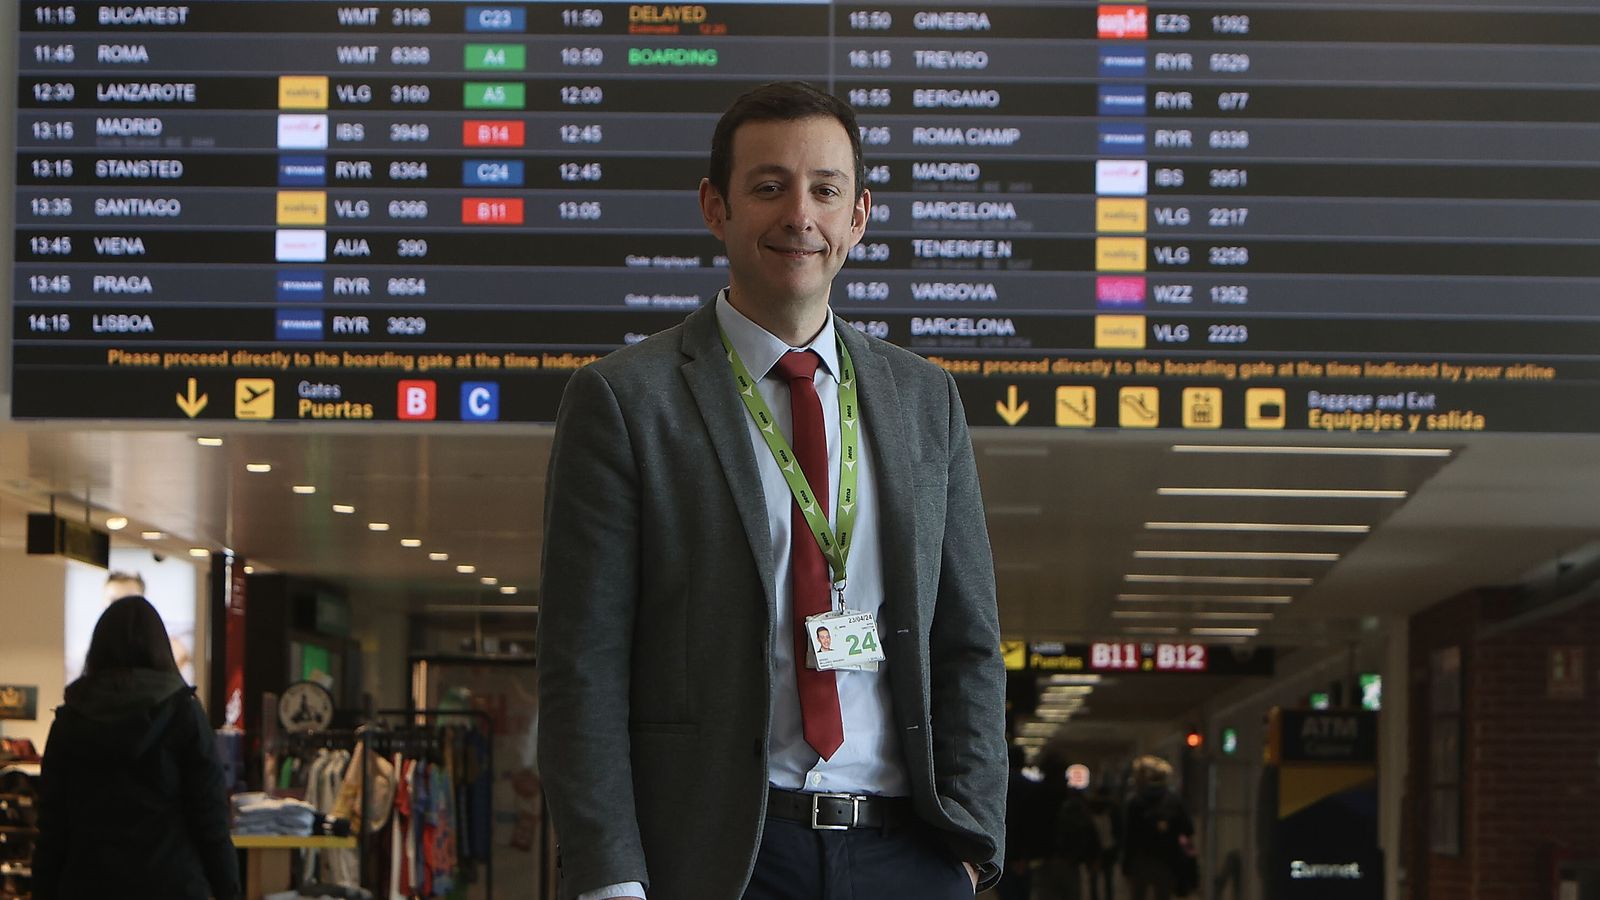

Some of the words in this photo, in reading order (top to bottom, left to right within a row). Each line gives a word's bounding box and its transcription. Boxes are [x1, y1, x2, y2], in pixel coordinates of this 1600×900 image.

[34, 7, 76, 24] 11:15
[99, 6, 189, 25] BUCAREST
[338, 8, 379, 26] WMT
[479, 10, 512, 27] C23
[562, 9, 603, 27] 11:50
[628, 5, 707, 23] DELAYED
[849, 11, 892, 30] 15:50
[913, 12, 991, 31] GINEBRA
[1155, 14, 1191, 33] EZS
[34, 45, 75, 63] 11:45
[97, 45, 149, 63] ROMA
[336, 46, 379, 64] WMT
[483, 48, 506, 65] A4
[561, 47, 603, 66] 10:50
[628, 48, 719, 66] BOARDING
[848, 50, 891, 69] 16:15
[913, 50, 989, 70] TREVISO
[1155, 53, 1193, 71] RYR
[33, 83, 75, 101] 12:30
[97, 83, 197, 102] LANZAROTE
[336, 84, 373, 103] VLG
[482, 86, 507, 104] A5
[560, 86, 603, 104] 12:00
[912, 89, 1001, 108] BERGAMO
[1155, 91, 1193, 110] RYR
[32, 122, 73, 140] 13:15
[96, 117, 163, 136] MADRID
[336, 123, 365, 141] IBS
[478, 124, 509, 143] B14
[560, 124, 602, 143] 12:45
[912, 127, 965, 146] ROMA
[1155, 129, 1193, 148] RYR
[31, 160, 73, 178] 13:15
[95, 159, 184, 179] STANSTED
[335, 161, 373, 179] RYR
[476, 163, 509, 181] C24
[559, 162, 602, 181] 12:45
[912, 163, 981, 182] MADRID
[31, 198, 73, 216] 13:35
[94, 198, 182, 217] SANTIAGO
[334, 200, 370, 219] VLG
[477, 202, 507, 220] B11
[559, 202, 602, 220] 13:05
[912, 201, 1018, 221] BARCELONA
[1154, 207, 1191, 226] VLG
[1208, 207, 1249, 227] 2217
[30, 236, 72, 255] 13:45
[93, 236, 146, 256] VIENA
[333, 238, 372, 257] AUA
[1153, 246, 1191, 265] VLG
[29, 275, 72, 293] 13:45
[92, 275, 154, 294] PRAGA
[333, 277, 371, 296] RYR
[910, 282, 999, 302] VARSOVIA
[1152, 285, 1194, 305] WZZ
[28, 313, 71, 332] 14:15
[92, 313, 155, 333] LISBOA
[332, 315, 370, 335] RYR
[849, 320, 890, 340] 9:50
[910, 317, 1017, 337] BARCELONA
[1152, 323, 1190, 343] VLG
[1207, 324, 1249, 344] 2223
[107, 349, 161, 366] Please
[163, 350, 229, 370] proceed
[231, 350, 291, 371] directly
[294, 352, 311, 366] to
[313, 351, 340, 367] the
[342, 351, 415, 371] boarding
[416, 353, 453, 371] gate
[455, 354, 473, 368] at
[474, 352, 501, 368] the
[503, 352, 540, 369] time
[983, 358, 1049, 377] proceed
[1051, 358, 1112, 378] directly
[1115, 359, 1133, 375] to
[1135, 359, 1162, 376] the
[1164, 359, 1237, 379] boarding
[1239, 361, 1276, 380] gate
[1278, 361, 1295, 376] at
[1297, 361, 1324, 377] the
[1326, 361, 1362, 378] time
[1364, 361, 1439, 379] indicated
[1441, 362, 1463, 382] by
[1464, 365, 1502, 383] your
[1504, 363, 1556, 380] airline
[298, 380, 342, 398] Gates
[299, 398, 374, 418] Puertas
[406, 387, 427, 416] B
[468, 387, 491, 416] C
[1307, 390, 1374, 412] Baggage
[1376, 392, 1405, 410] and
[1307, 409, 1404, 433] Equipajes
[1408, 412, 1423, 433] y
[1425, 410, 1486, 431] salida
[845, 631, 877, 656] 24
[1091, 643, 1137, 669] B11
[1156, 643, 1206, 669] B12
[1301, 715, 1359, 739] ATM
